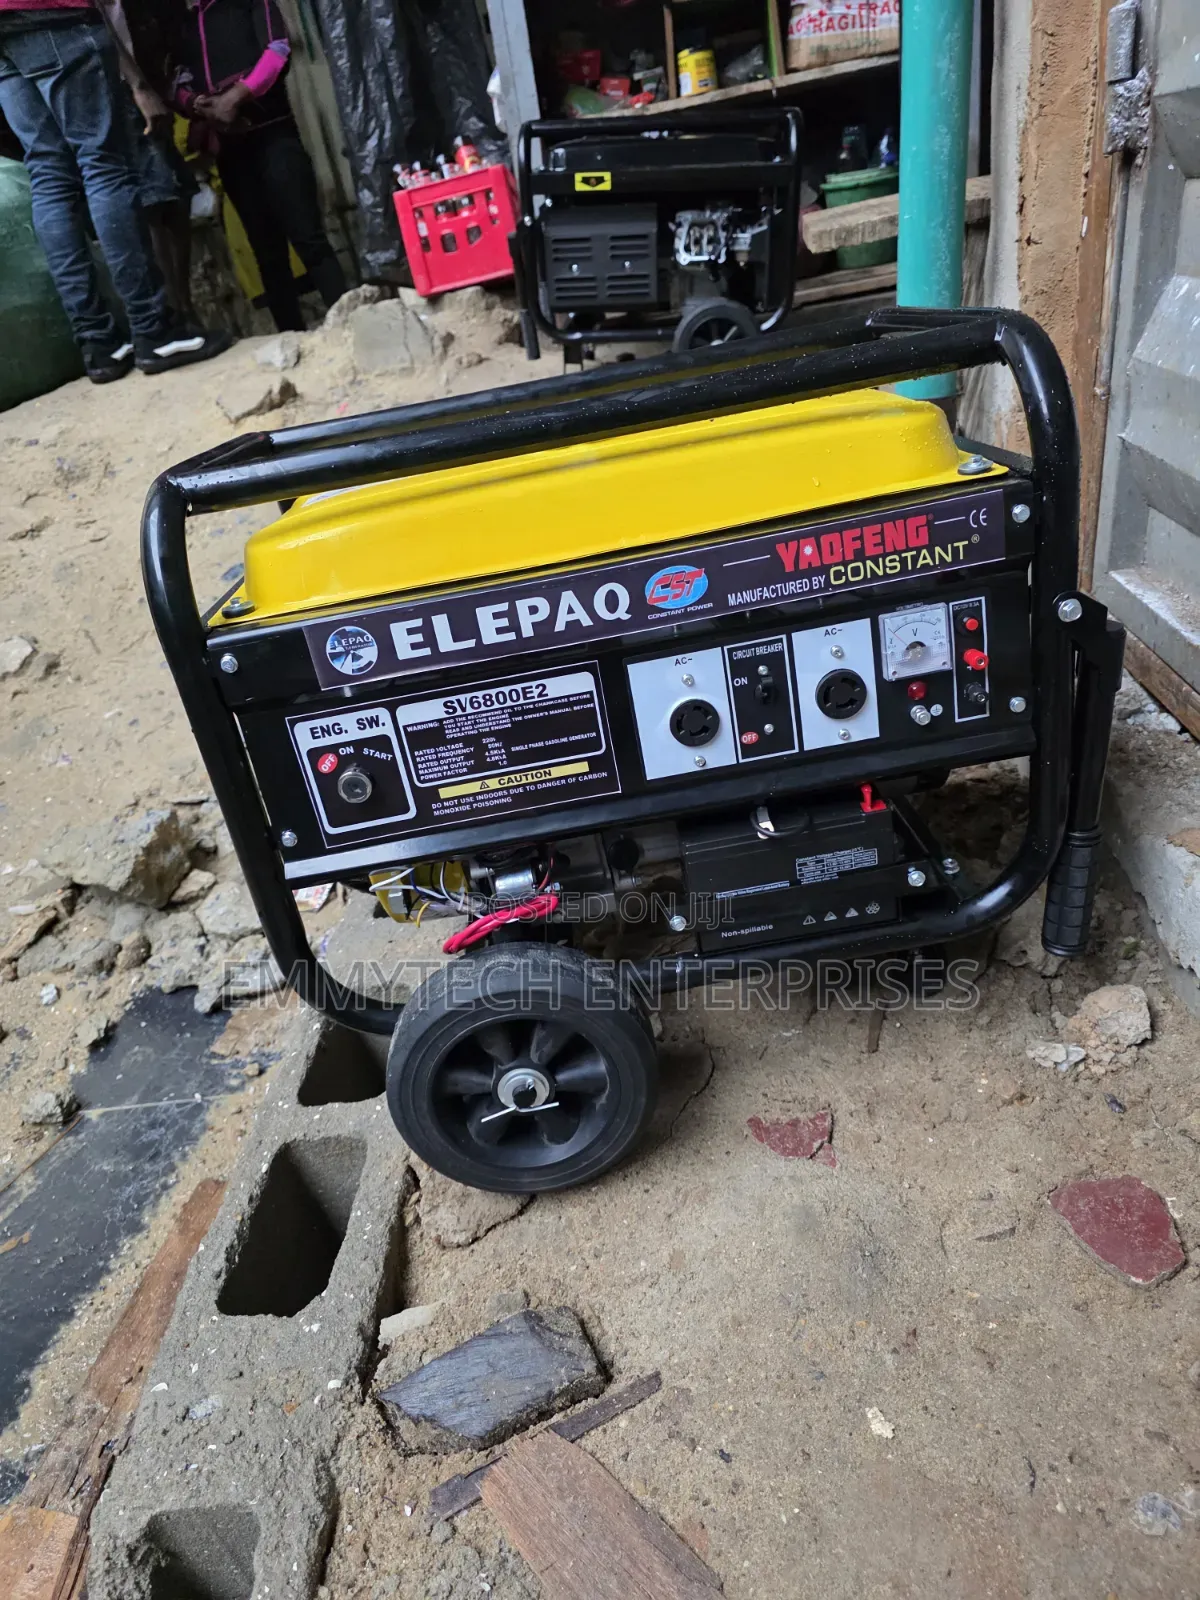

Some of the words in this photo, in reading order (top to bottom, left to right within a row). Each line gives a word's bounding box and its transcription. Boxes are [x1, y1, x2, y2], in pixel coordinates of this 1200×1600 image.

[969, 508, 988, 528] CE
[776, 514, 929, 573] YAOFENG
[727, 578, 809, 607] MANUFACTURED
[812, 575, 825, 587] BY
[829, 540, 969, 585] CONSTANT
[647, 568, 705, 605] CST
[647, 608, 685, 620] CONSTANT
[687, 602, 714, 612] POWER
[389, 581, 632, 661] ELEPAQ
[732, 647, 755, 660] CIRCUIT
[755, 642, 783, 656] BREAKER
[733, 676, 748, 687] ON
[442, 683, 549, 716] SV6800E2
[406, 721, 440, 732] WARNING:
[569, 693, 591, 702] BEFORE
[474, 718, 511, 729] UNDERSTAND
[523, 710, 548, 720] OWNER'S
[549, 707, 572, 715] MANUAL
[573, 703, 594, 711] BEFORE
[488, 713, 509, 721] ENGINE
[309, 722, 349, 740] ENG.
[356, 714, 386, 731] SW.
[446, 729, 478, 739] OPERATING
[491, 723, 512, 731] ENGINE
[511, 744, 529, 752] SINGLE
[545, 737, 568, 746] GASOLINE
[568, 732, 597, 741] GENERATOR
[741, 734, 757, 744] OFF
[338, 745, 355, 756] ON
[363, 747, 393, 761] START
[414, 748, 435, 757] RATED
[436, 742, 464, 752] VOLTAGE
[416, 753, 437, 762] RATED
[438, 747, 475, 759] FREQUENCY
[321, 754, 336, 772] OFF
[417, 760, 439, 769] RATED
[440, 756, 465, 765] OUTPUT
[419, 765, 449, 775] MAXIMUM
[449, 760, 475, 769] OUTPUT
[420, 772, 443, 781] POWER
[443, 767, 468, 776] FACTOR
[497, 769, 552, 786] CAUTION
[431, 802, 442, 810] DO
[443, 799, 458, 808] NOT
[460, 796, 475, 804] USE
[476, 790, 508, 801] INDOORS
[509, 786, 524, 795] DUE
[525, 784, 536, 792] TO
[537, 778, 567, 790] DANGER
[578, 771, 608, 782] CARBON
[433, 805, 472, 816] MONOXIDE
[472, 796, 512, 808] POISONING
[721, 924, 774, 938] Non-spillable
